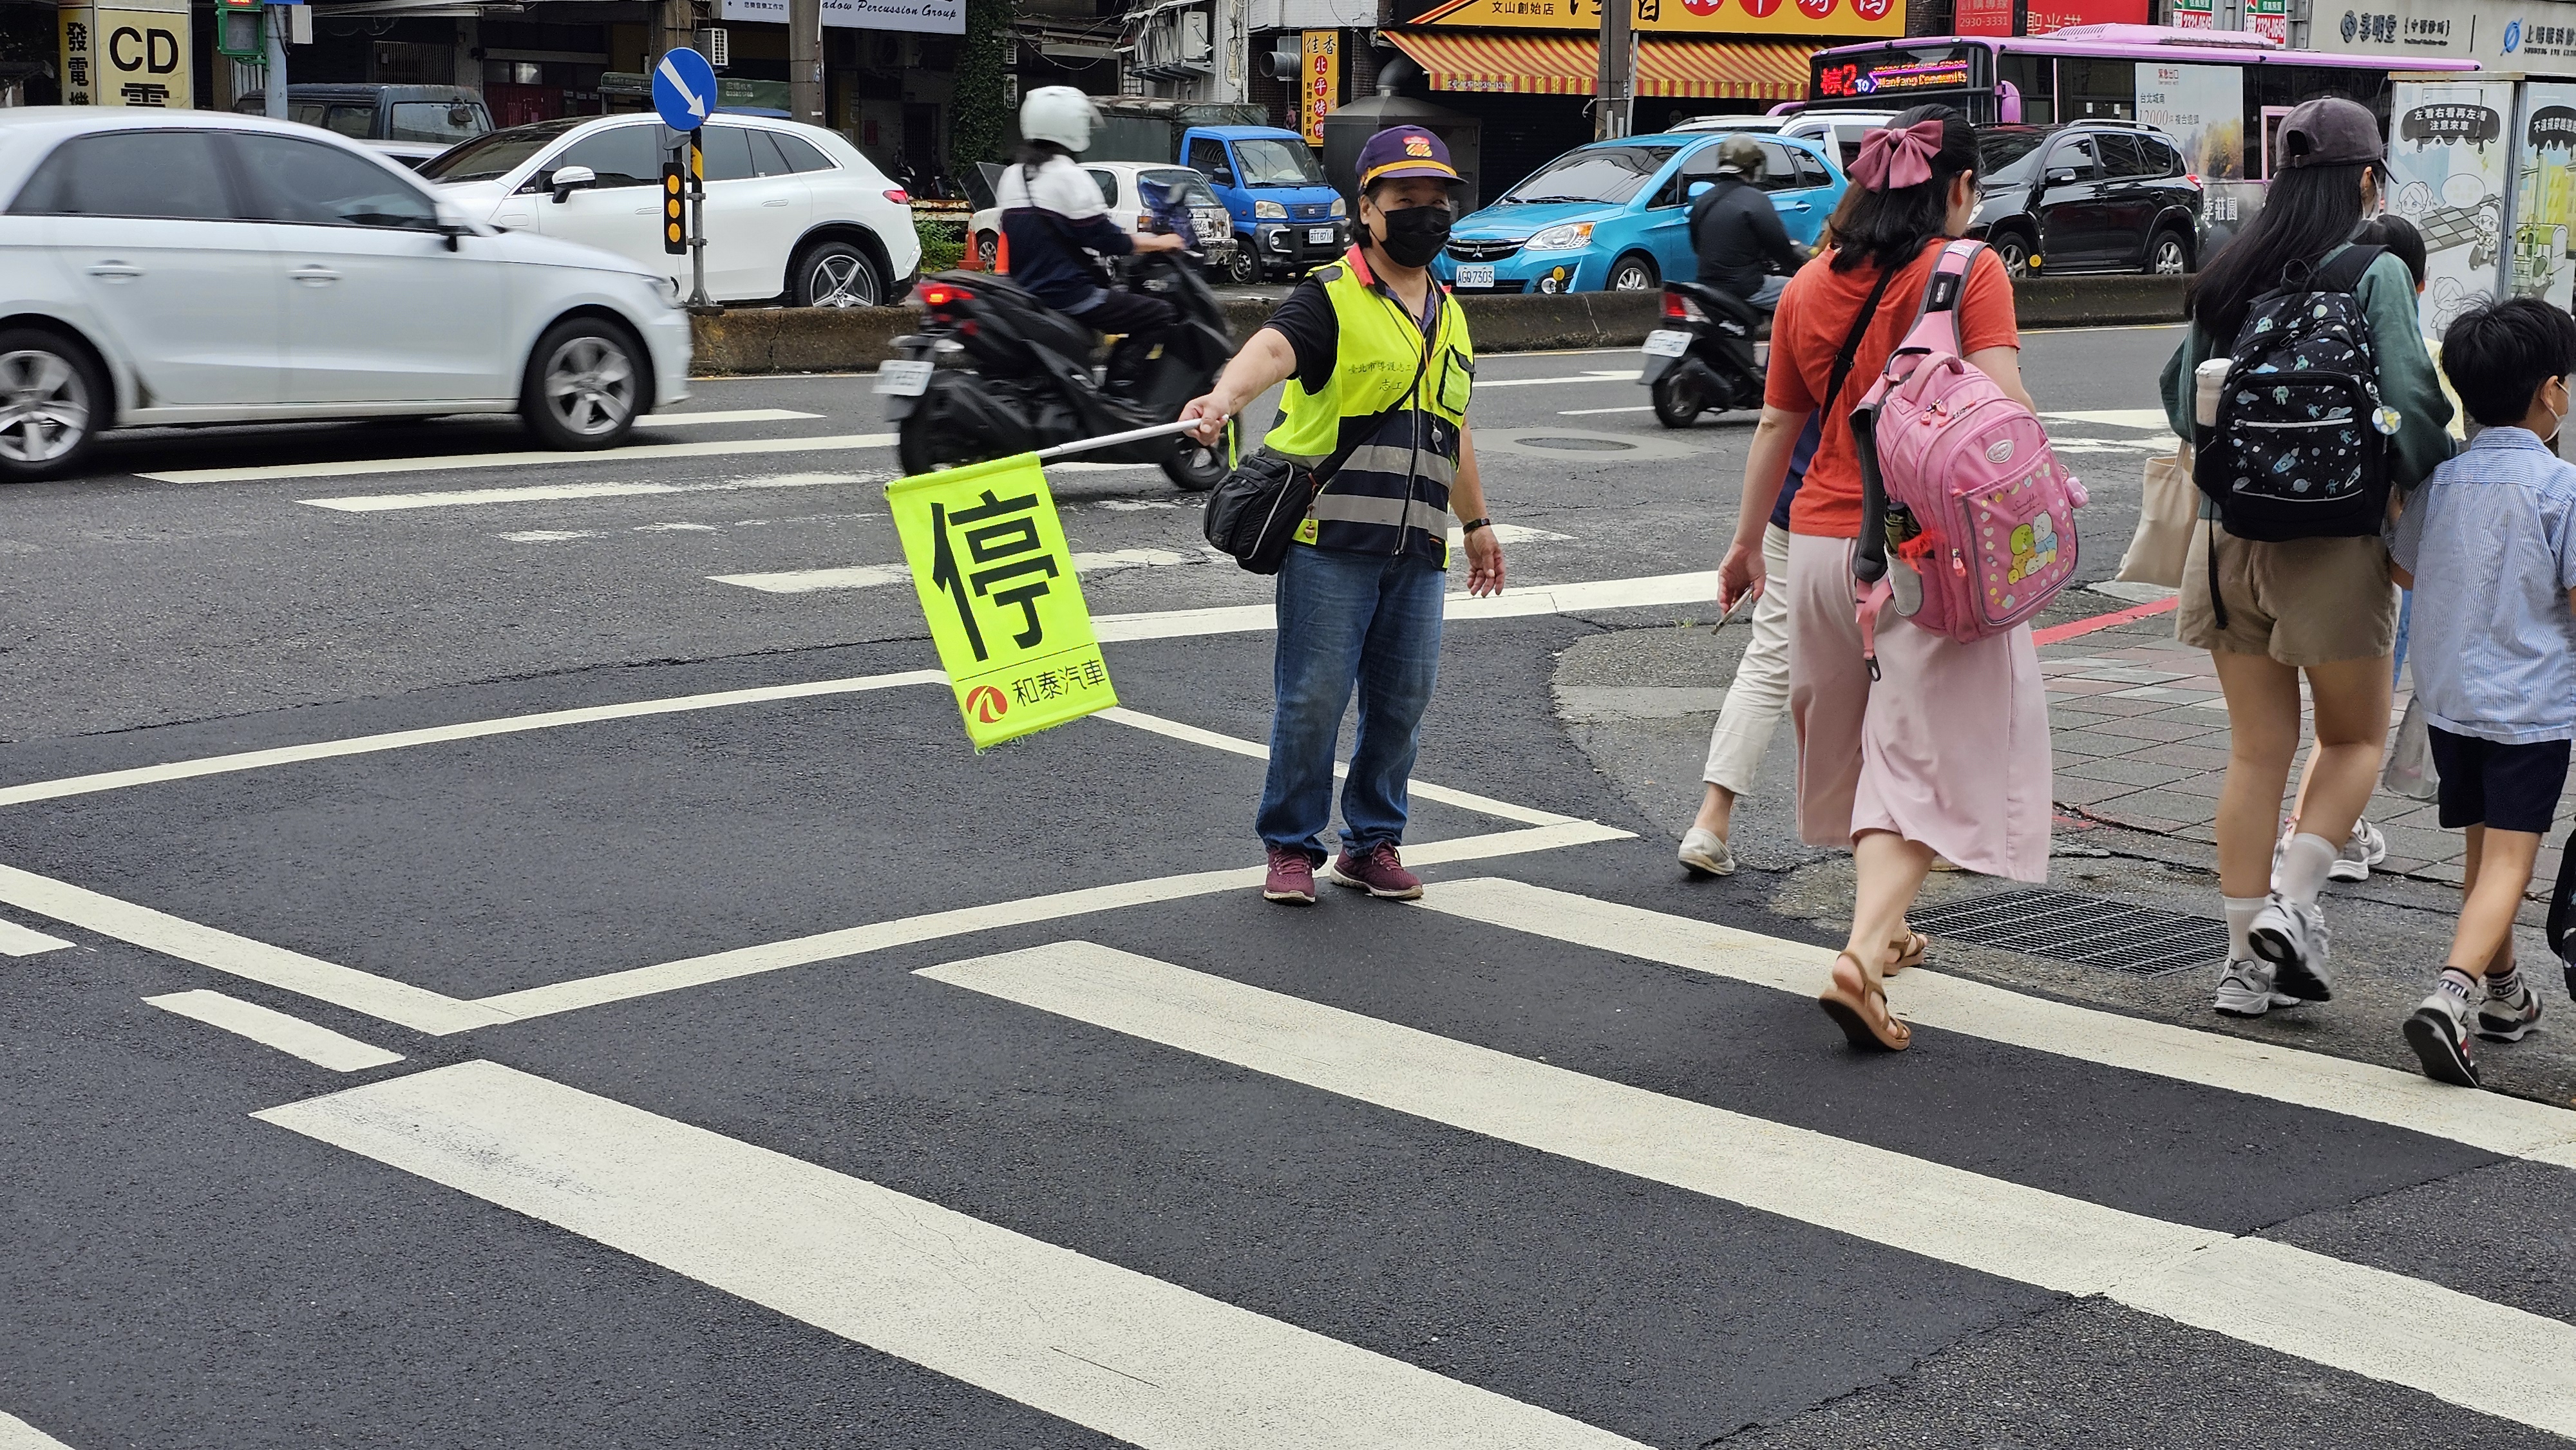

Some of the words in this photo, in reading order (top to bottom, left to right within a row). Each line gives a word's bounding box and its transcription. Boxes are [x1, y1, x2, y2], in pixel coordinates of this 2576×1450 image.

[822, 0, 852, 10] adow
[857, 0, 918, 15] Percussion
[922, 5, 957, 20] Group
[1491, 1, 1554, 15] 文山創始店
[1960, 16, 2008, 27] 2930-3331
[109, 26, 179, 74] CD
[1306, 34, 1336, 54] 佳香
[1314, 55, 1328, 138] 北平烤鴨
[2140, 92, 2165, 104] 台北城南
[2414, 108, 2487, 122] 左看右看再左看
[2430, 120, 2470, 131] 注意來車
[1379, 379, 1402, 391] 志工
[931, 489, 1059, 662] 停
[1012, 659, 1106, 707] 和泰汽車
